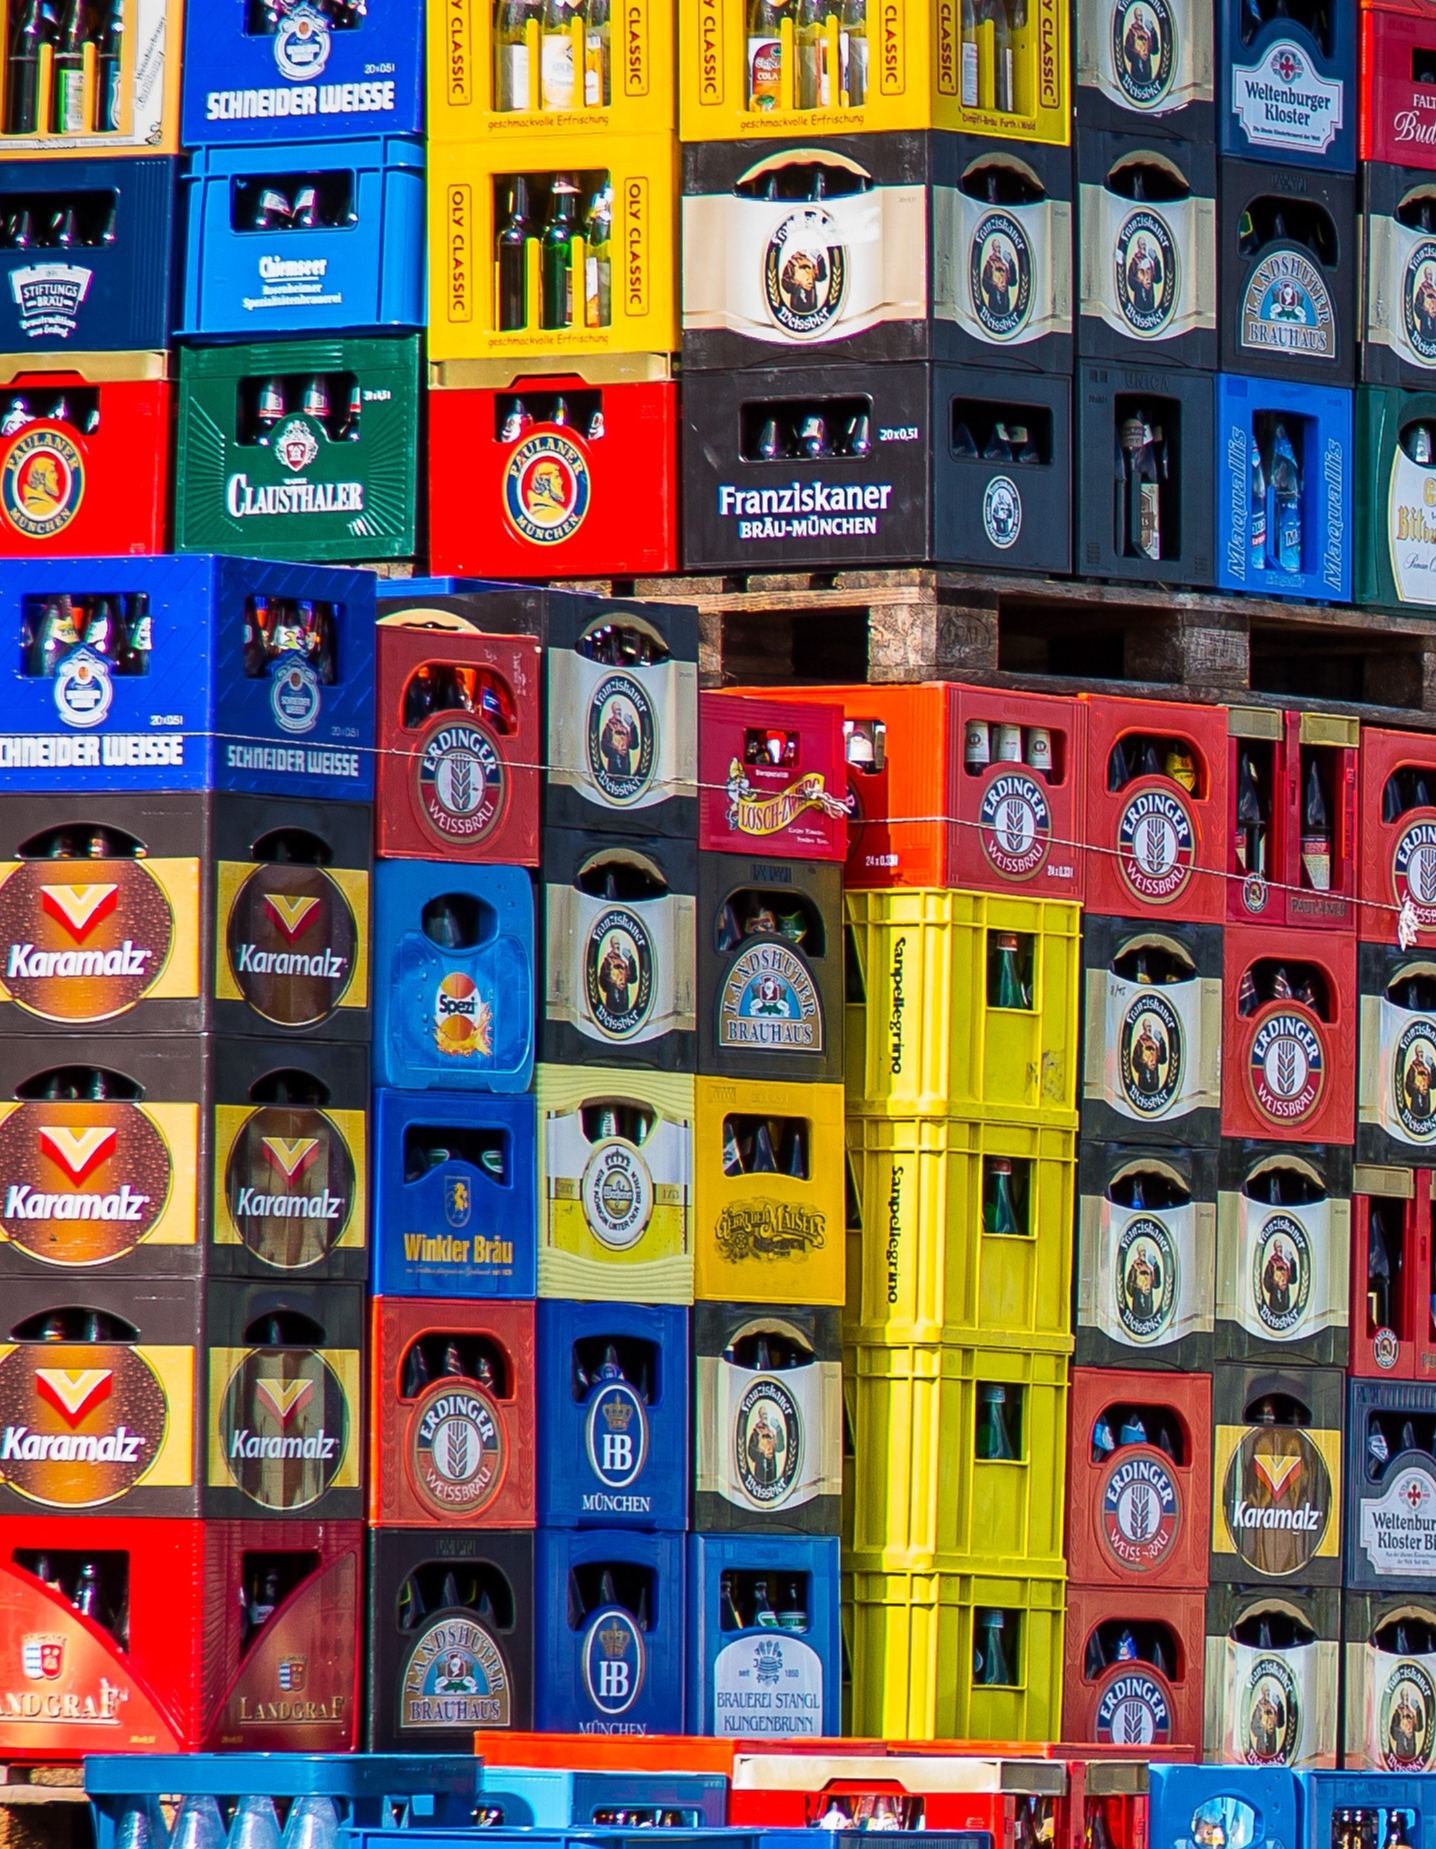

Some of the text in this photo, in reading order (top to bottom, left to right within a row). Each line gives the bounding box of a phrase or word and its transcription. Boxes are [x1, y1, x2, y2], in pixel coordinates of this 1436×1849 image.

[628, 7, 643, 86] CLASSIC
[756, 72, 779, 81] COLA
[207, 81, 395, 120] SCHNEIDER WEISSE
[1244, 80, 1331, 113] Weltenburger
[487, 114, 610, 132] geschmackvolle Erfrischung
[740, 113, 864, 131] geschmackvolle Erfrischung
[1263, 102, 1310, 126] Kloster
[452, 190, 465, 312] OLY CLASSIC
[628, 184, 641, 305] OLY CLASSIC
[974, 217, 1026, 253] Franziskaner
[258, 256, 327, 278] Chiemseer
[23, 284, 79, 300] STIFTUNGS
[36, 295, 65, 311] BRÄU
[1246, 254, 1330, 329] LANDSHUTER
[975, 303, 1020, 332] Weissbier
[509, 437, 585, 477] PAULANER
[226, 474, 363, 517] CLAUSTHALER
[719, 480, 892, 515] Franziskaner
[1226, 427, 1248, 581] Maquallis
[516, 509, 577, 542] MÜNCHEN
[740, 517, 876, 538] BRÄU-MÜNCHEN
[103, 735, 184, 766] WEISSE
[226, 745, 360, 777] SCHNEIDER WEISSE
[423, 727, 499, 773] ERDINGER
[428, 800, 494, 835] WEISSBRÄU
[8, 941, 148, 977] Karamalz
[238, 944, 343, 979] Karamalz
[439, 994, 476, 1015] Spezi
[404, 1232, 513, 1265] Winkler Bräu
[603, 1430, 633, 1470] HB
[582, 1491, 650, 1512] MÜNCHEN
[1376, 1532, 1419, 1553] Kloster
[404, 1621, 505, 1696] LANDSHUTER
[738, 1669, 750, 1677] seit
[239, 1695, 345, 1723] LANDGRAF
[717, 1693, 819, 1709] BRAUEREI STANGL
[724, 1715, 814, 1732] KLINGENBRUNN
